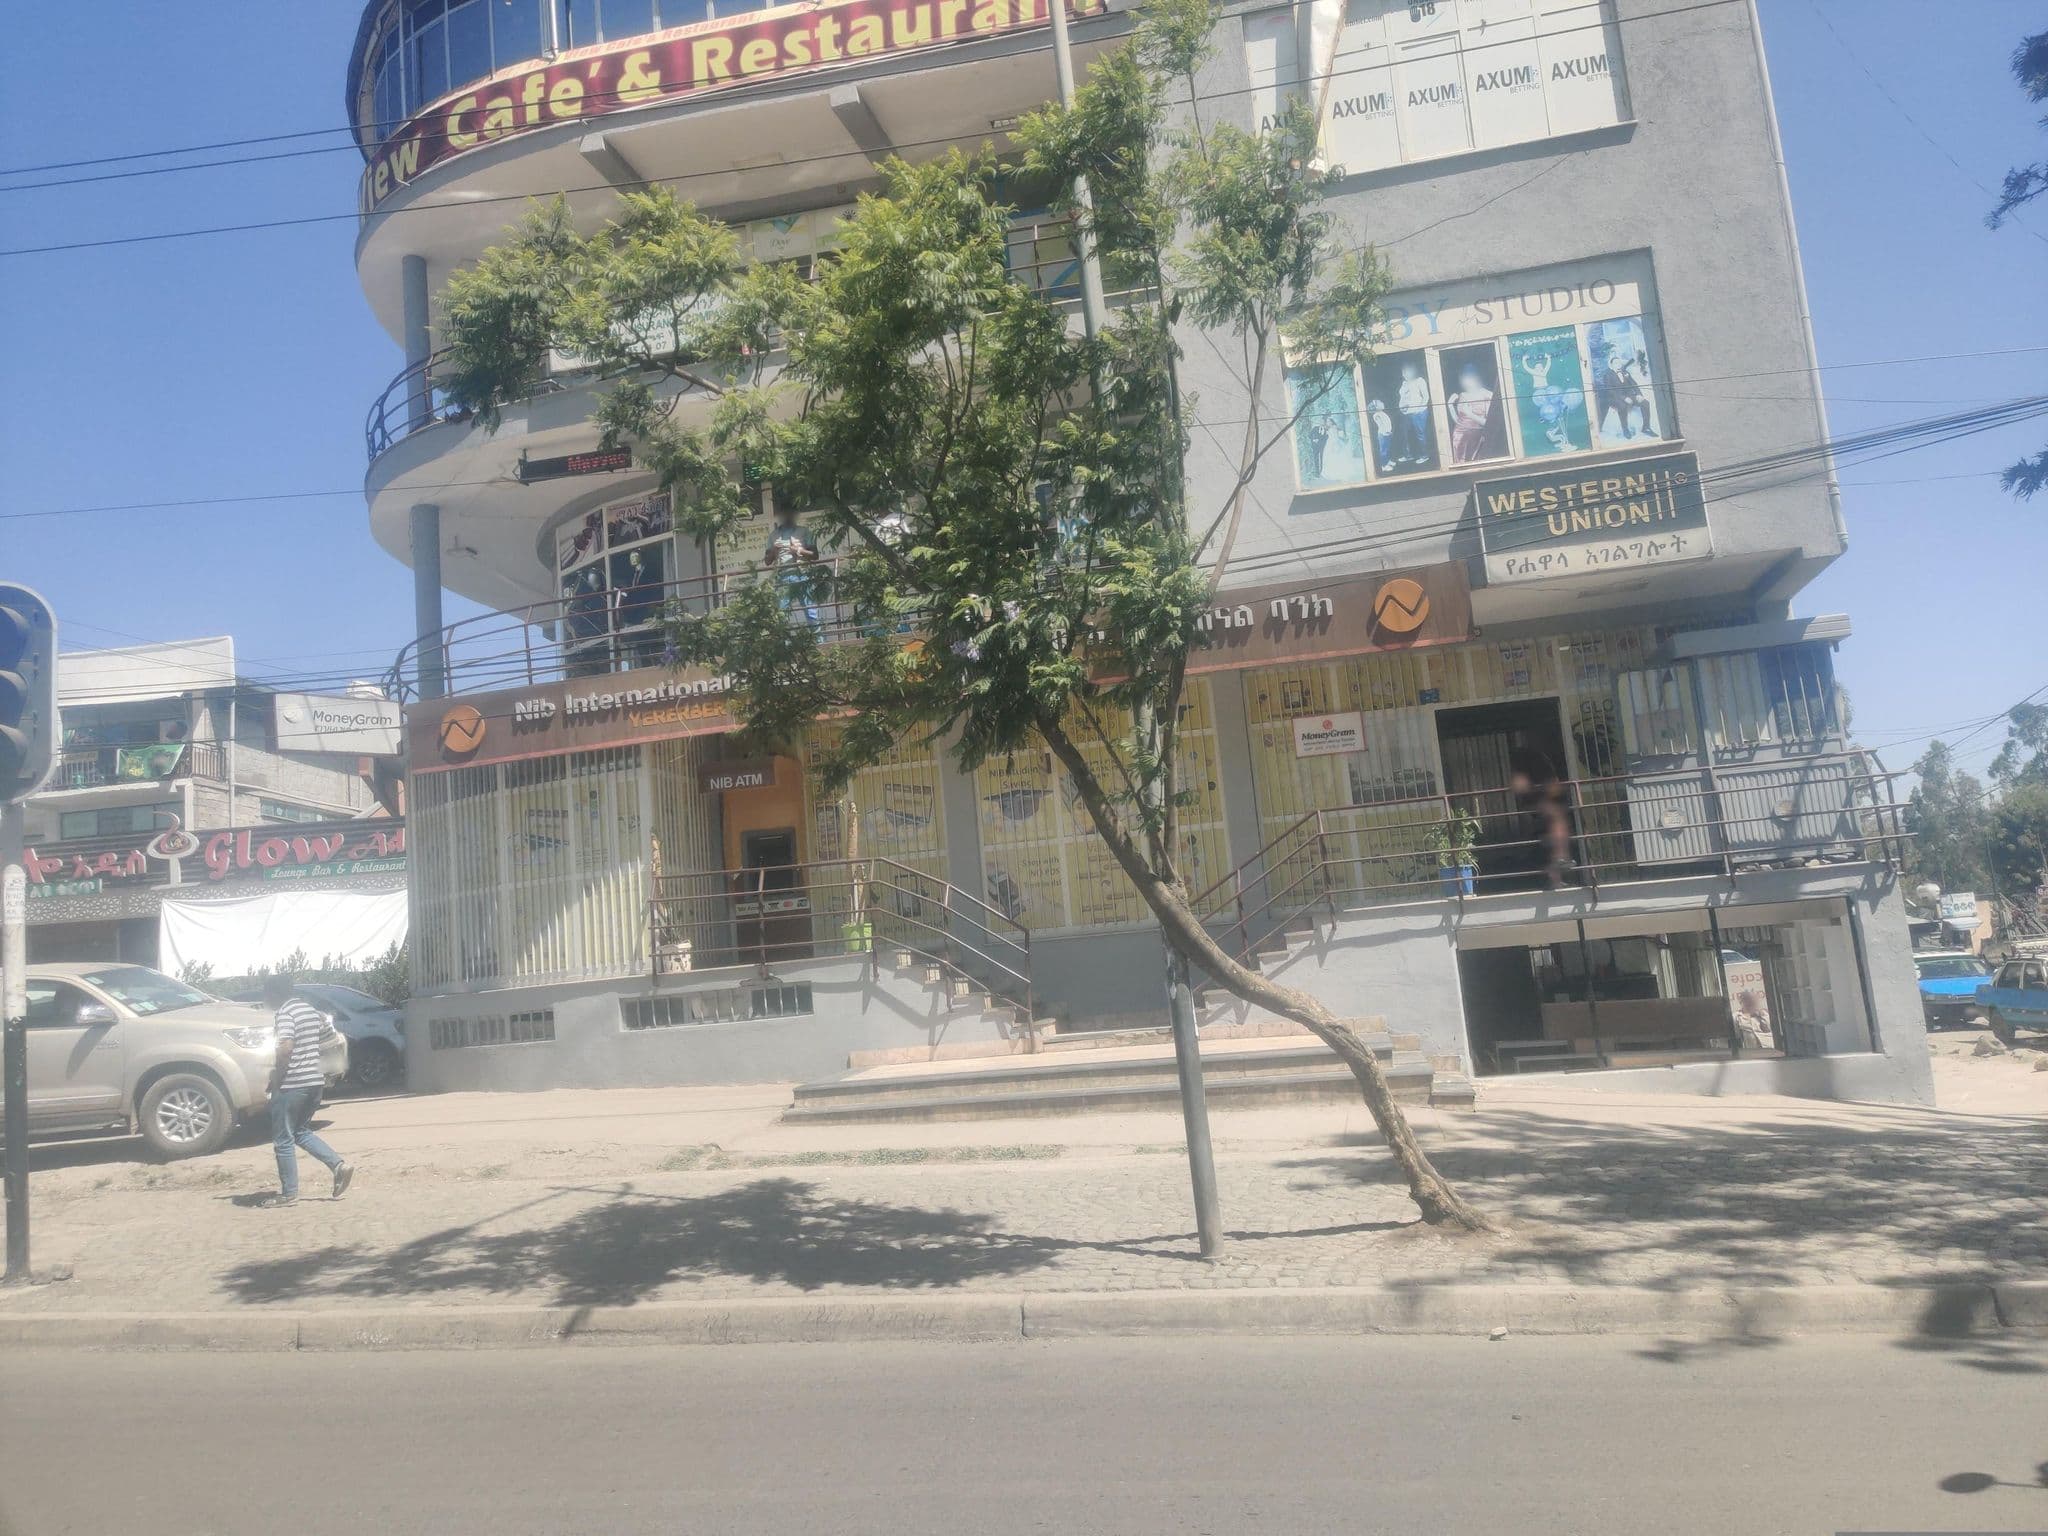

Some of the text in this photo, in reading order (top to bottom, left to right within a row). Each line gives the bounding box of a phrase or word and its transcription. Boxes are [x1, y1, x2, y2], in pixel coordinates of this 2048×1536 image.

[616, 51, 663, 103] &
[1476, 66, 1531, 92] AXUM
[1551, 54, 1608, 81] AXUM
[1408, 83, 1457, 107] AXUM
[1510, 83, 1541, 94] BETTING
[1333, 92, 1386, 120] AXUM
[1472, 278, 1617, 325] STUDIO
[1488, 472, 1647, 517] WESTERN
[1547, 500, 1651, 536] UNION
[1270, 593, 1334, 621] ባንክ
[514, 674, 735, 723] Nib International
[312, 710, 393, 727] MoneyGram
[1301, 728, 1357, 742] MoneyGram
[710, 773, 762, 790] NIB ATM
[336, 863, 346, 874] &
